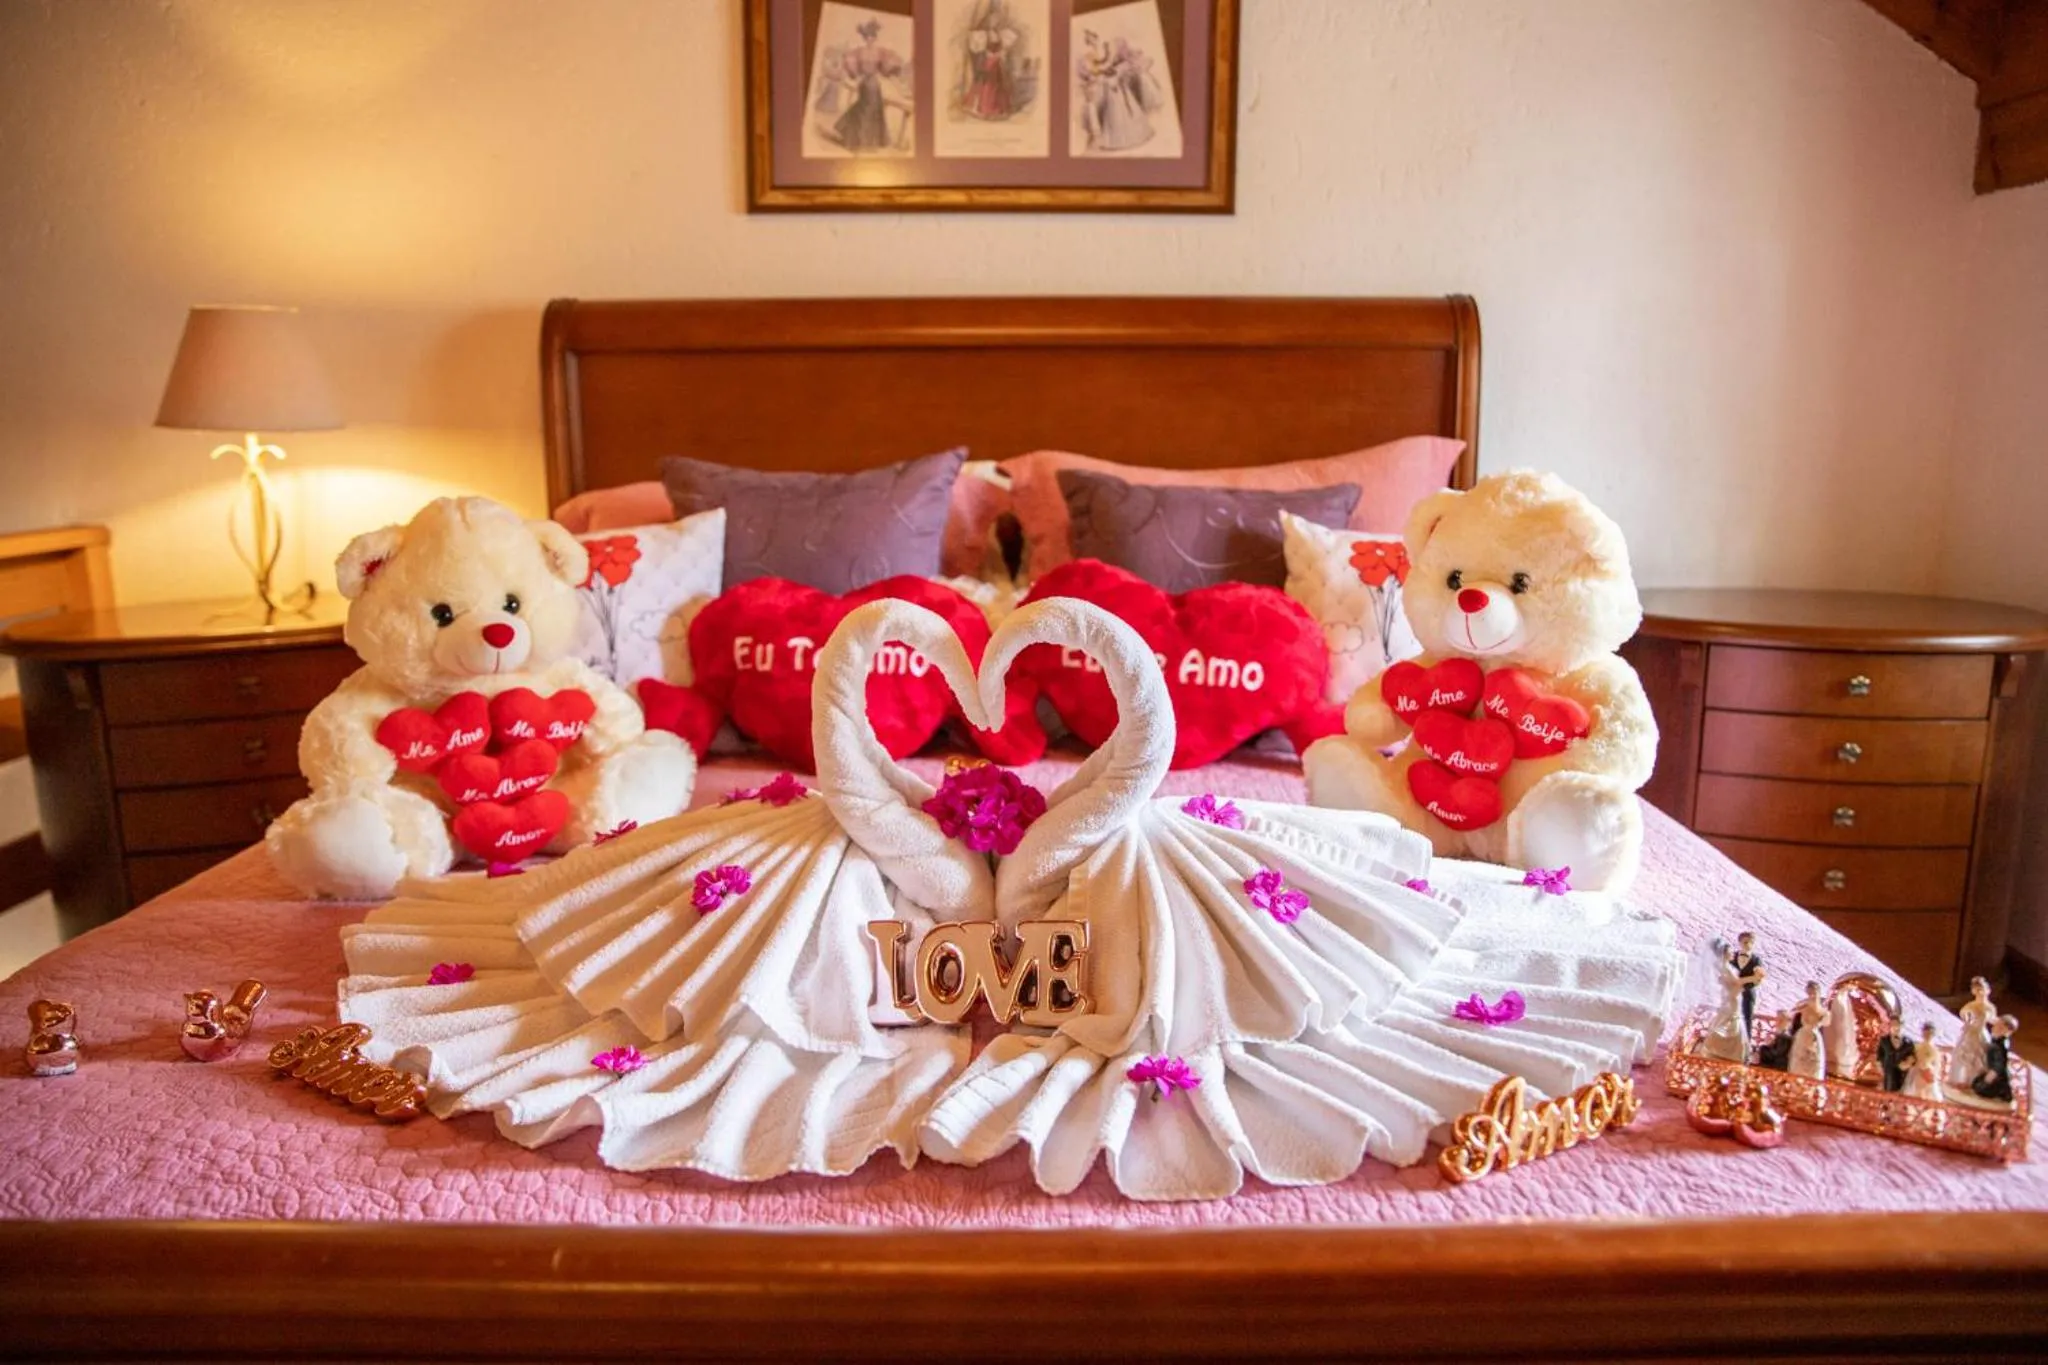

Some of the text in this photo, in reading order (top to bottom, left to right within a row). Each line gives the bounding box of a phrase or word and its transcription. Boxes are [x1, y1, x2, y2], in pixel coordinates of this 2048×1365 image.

[733, 636, 775, 672] Eu
[866, 645, 930, 678] mo
[1178, 648, 1264, 692] Amo
[1396, 687, 1466, 712] Me Ame
[1486, 694, 1509, 718] Me
[445, 727, 485, 752] Ame
[1445, 750, 1499, 773] Abrace
[495, 829, 546, 847] Amor
[867, 919, 1090, 1027] LOVE
[1437, 1072, 1642, 1185] Amor
